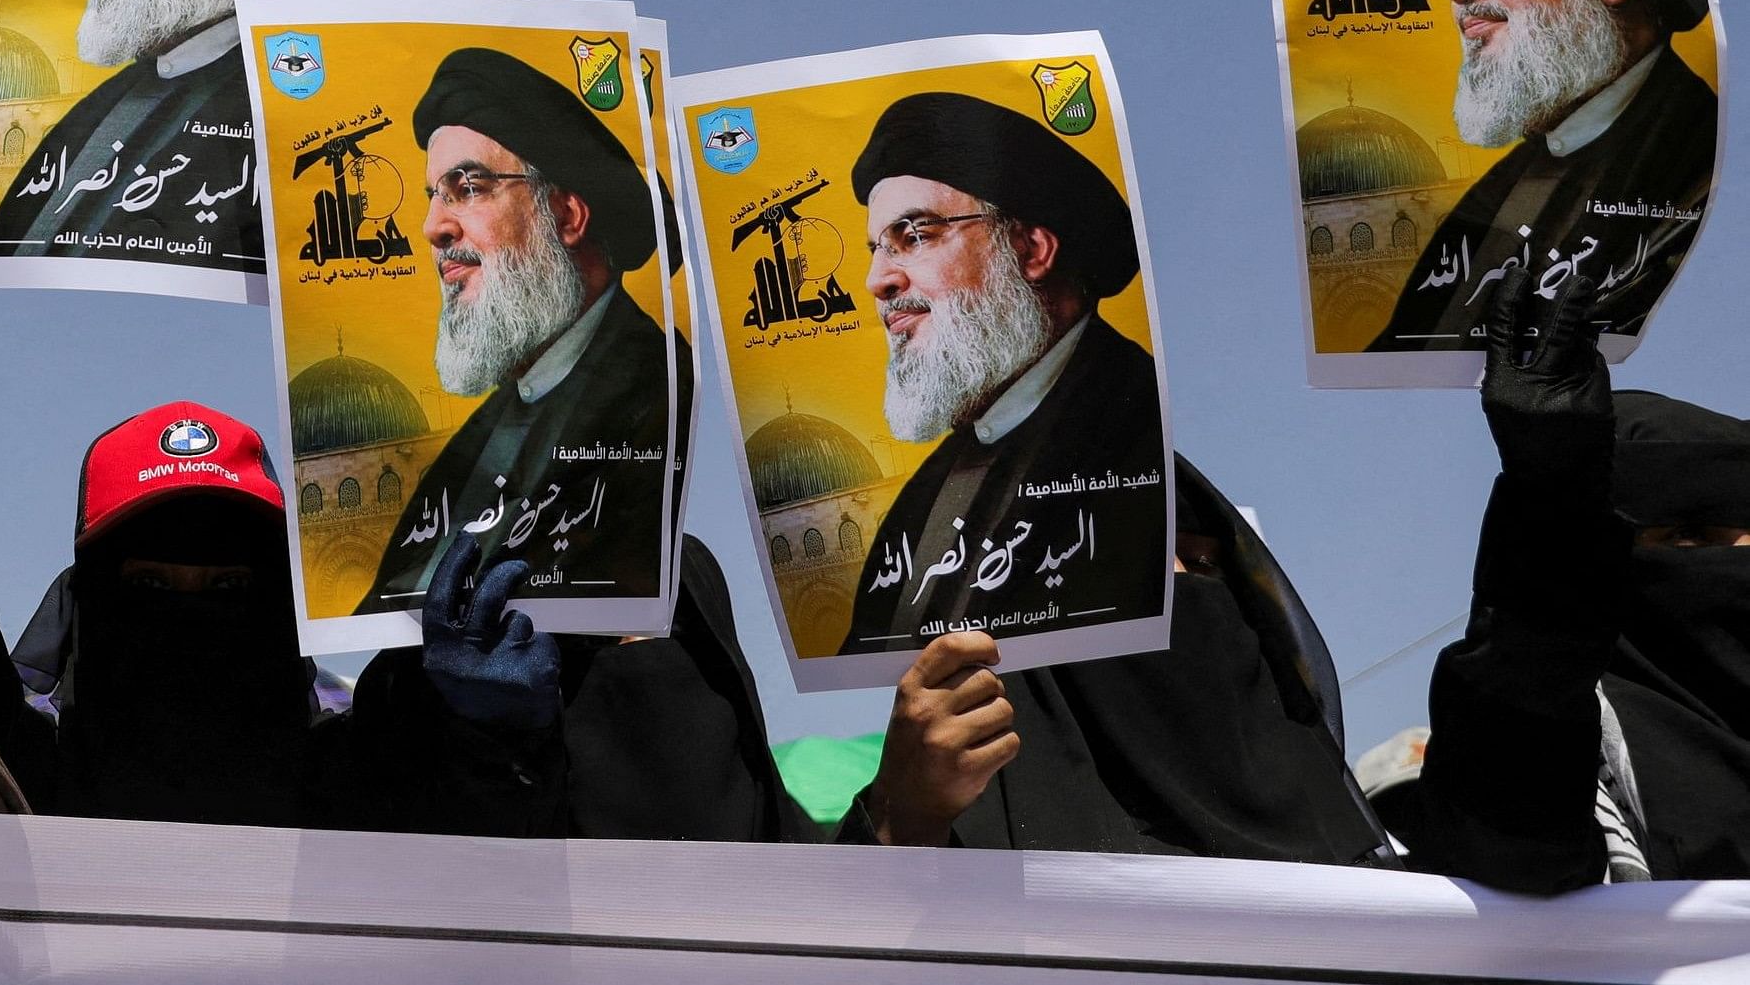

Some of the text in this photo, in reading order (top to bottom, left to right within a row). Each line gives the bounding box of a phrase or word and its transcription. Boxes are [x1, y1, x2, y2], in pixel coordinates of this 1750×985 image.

[1306, 21, 1434, 39] المقاومة الإسلامية في لبنان
[18, 145, 67, 196] الله
[54, 139, 124, 215] نصر
[113, 153, 192, 212] حسن
[54, 231, 212, 255] الأمين العام لحزب الله
[1418, 234, 1470, 291] الله
[299, 266, 415, 285] المقاومة الإسلامية في لبنان
[744, 321, 860, 348] المقاومة الإسلامية في لبنان
[168, 419, 205, 431] BMW
[138, 460, 239, 483] BMW Motorrad
[400, 474, 606, 552] السيد حسن نص الله
[868, 508, 1095, 605] السيد حسن نصر الله
[530, 565, 563, 586] الأمين
[990, 611, 1020, 629] العام
[1023, 602, 1059, 624] الأمين
[920, 621, 944, 636] الله
